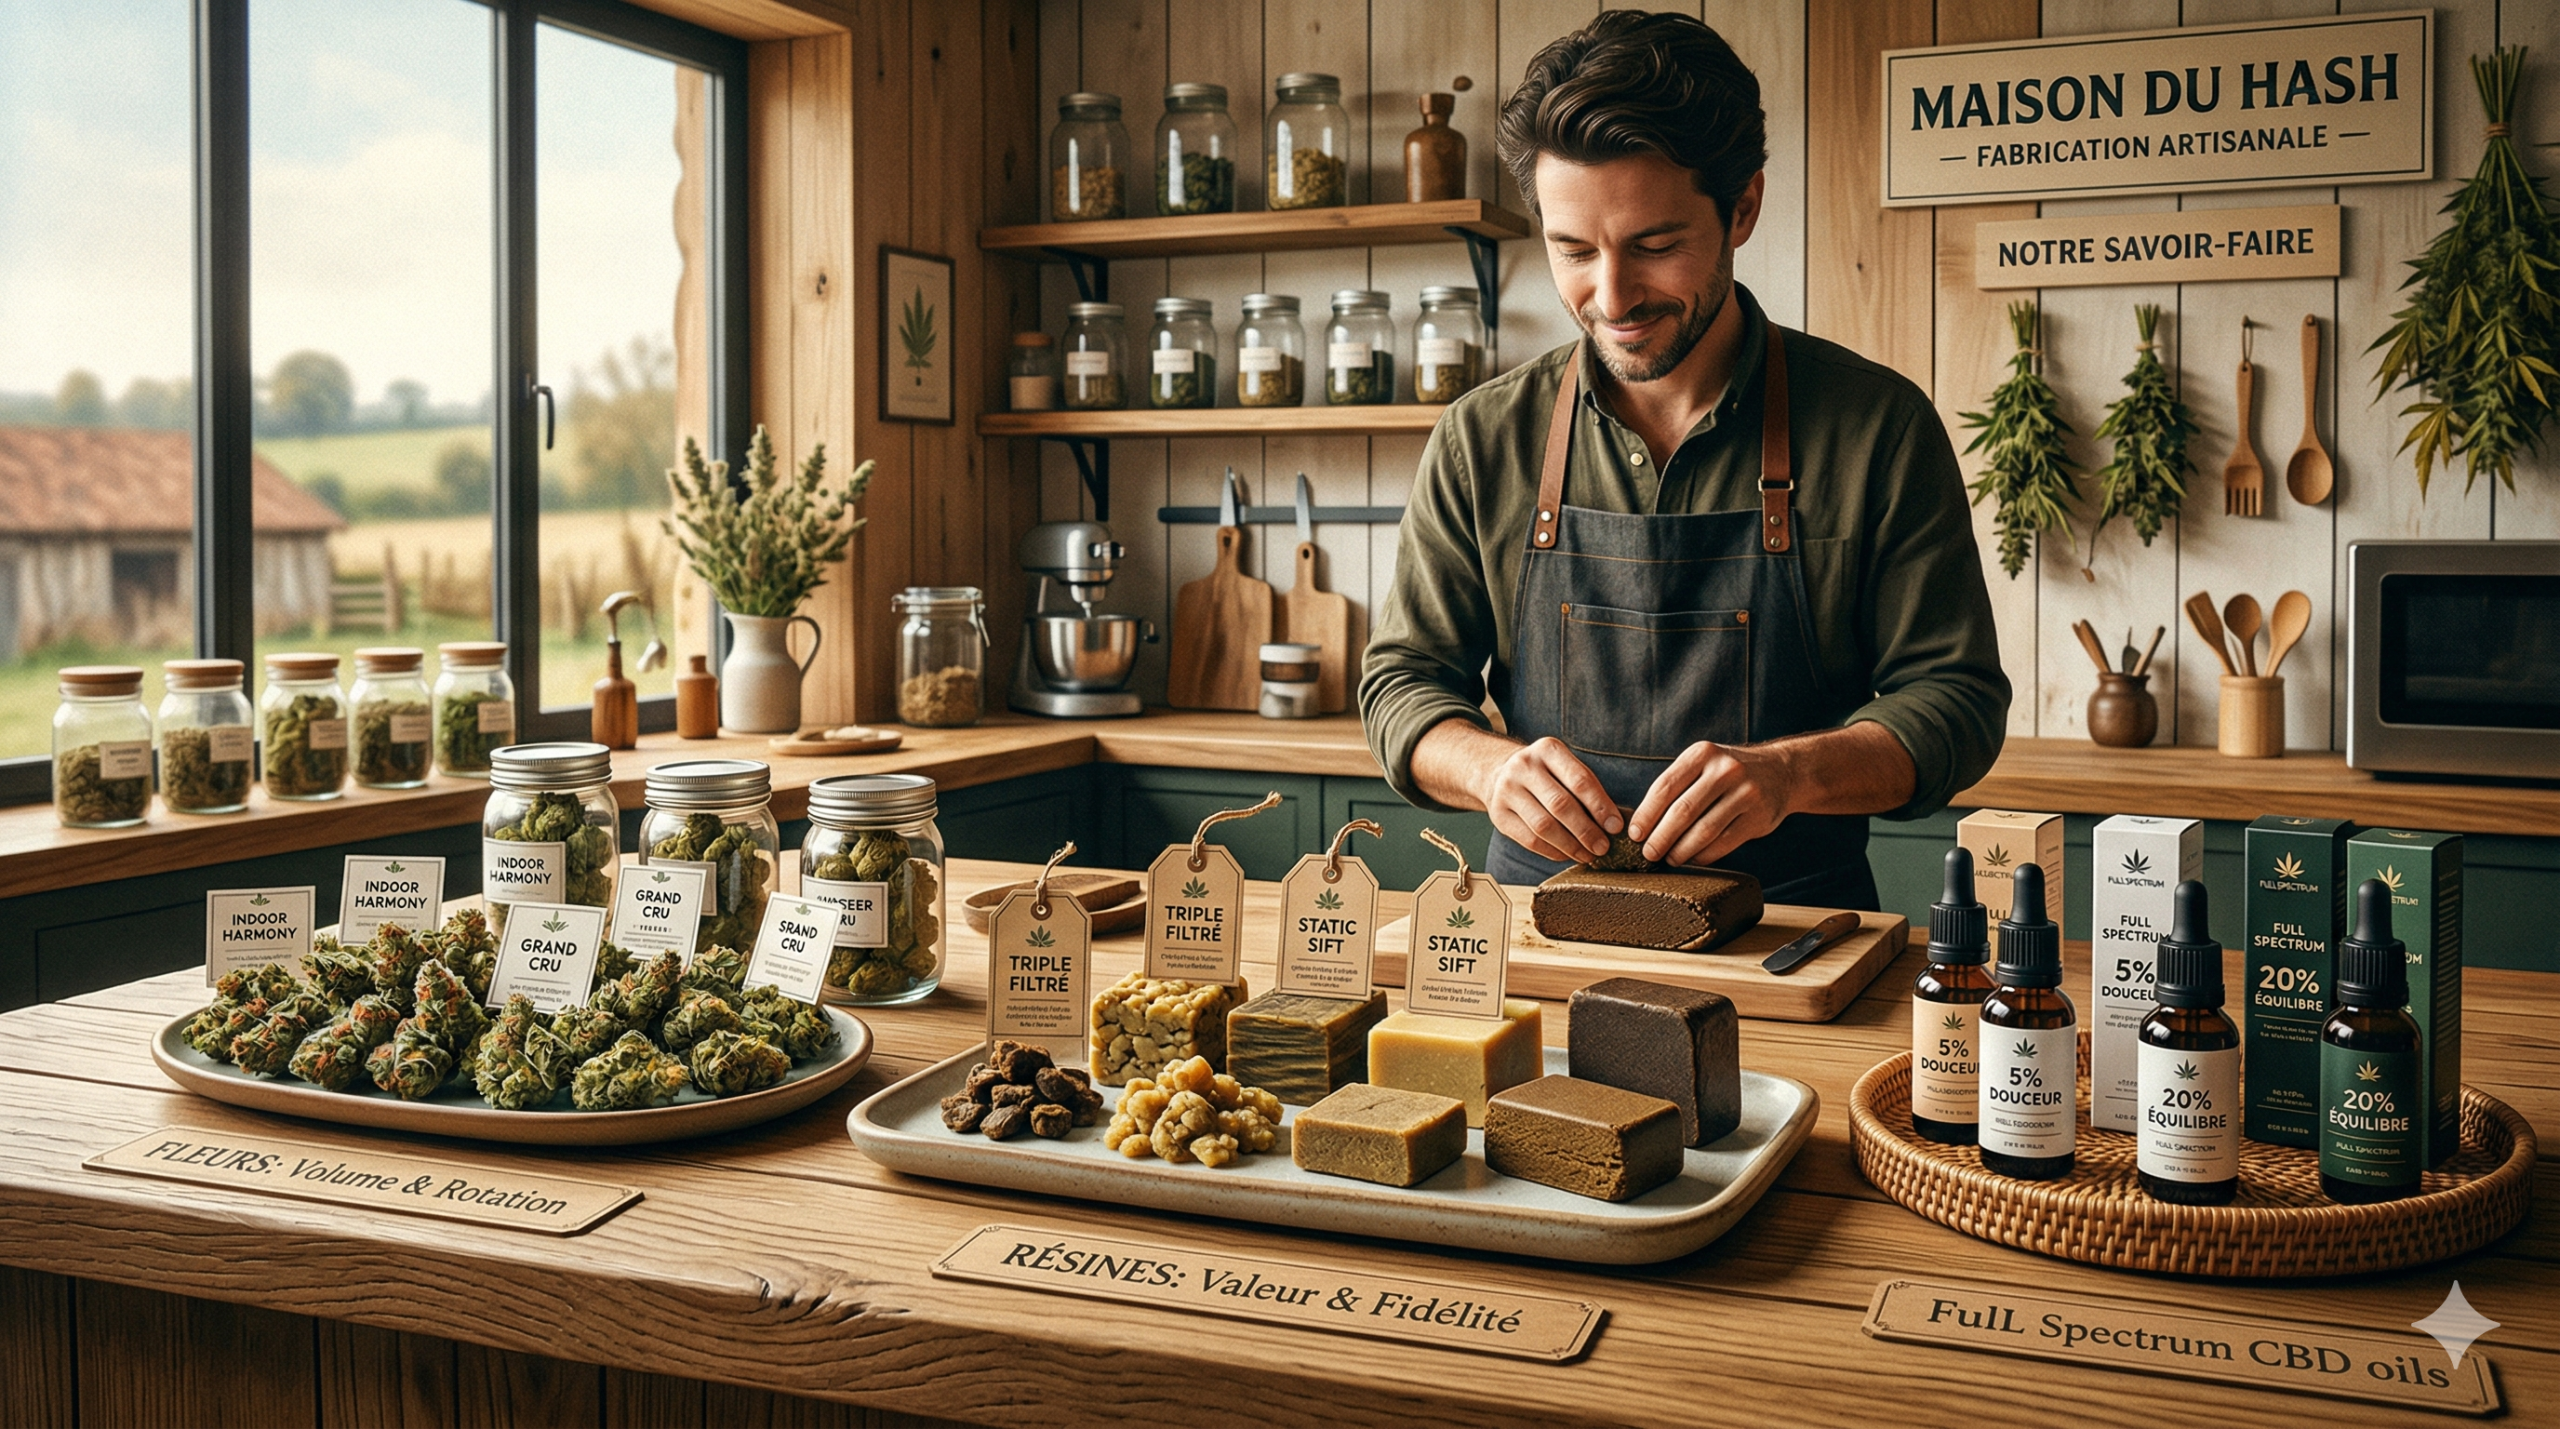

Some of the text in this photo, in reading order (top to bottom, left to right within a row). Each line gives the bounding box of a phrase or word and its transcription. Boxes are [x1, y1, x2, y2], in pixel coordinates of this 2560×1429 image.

[1910, 53, 2399, 131] MAISON DU HASH
[1977, 125, 2328, 168] FABRICATION ARTISANALE
[1998, 228, 2314, 267] NOTRE SAVOIR-FAIRE
[497, 856, 545, 870] INDOOR
[365, 880, 419, 894] INDOOR
[489, 870, 552, 885] HARMONY
[354, 896, 428, 910] HARMONY
[636, 889, 682, 904] GRAND
[232, 912, 288, 926] INDOOR
[642, 906, 670, 919] CRU
[840, 914, 856, 926] RU
[1164, 904, 1224, 924] TRIPLE
[2120, 915, 2152, 928] FULL
[222, 927, 298, 942] HARMONY
[778, 920, 818, 939] SRAND
[1165, 922, 1222, 943] FILTRÉ
[1298, 916, 1357, 937] STATIC
[2273, 922, 2306, 936] FULL
[520, 937, 578, 957] GRAND
[781, 938, 806, 953] CRU
[1307, 936, 1345, 955] SIFT
[1427, 935, 1489, 957] STATIC
[2254, 935, 2325, 953] SPECTRUM
[528, 955, 562, 974] CRU
[1009, 955, 1073, 973] TRIPLE
[1438, 955, 1478, 975] SIFT
[2114, 958, 2155, 984] 5%
[1009, 972, 1070, 993] FILTRÉ
[2259, 965, 2320, 994] 20%
[2101, 985, 2156, 1002] DOUCEU
[2254, 990, 2324, 1013] ÉQUILIBRE
[1938, 1038, 1969, 1058] 5%
[1921, 1057, 1980, 1075] DOUCEU
[2009, 1067, 2043, 1088] 5%
[1990, 1086, 2062, 1107] DOUCEUR
[2162, 1087, 2212, 1111] 20%
[2343, 1088, 2395, 1113] 20%
[2148, 1105, 2227, 1130] ÉQUILIBRE
[2329, 1105, 2409, 1132] ÉQUILIBRE
[143, 1140, 570, 1216] FLEURS: Volume & Rotation
[1000, 1241, 1522, 1334] RÉSINES: Valeur & Fidélité
[2039, 1313, 2235, 1361] Spectrum
[2248, 1338, 2352, 1376] CBD
[2366, 1355, 2452, 1389] oils
